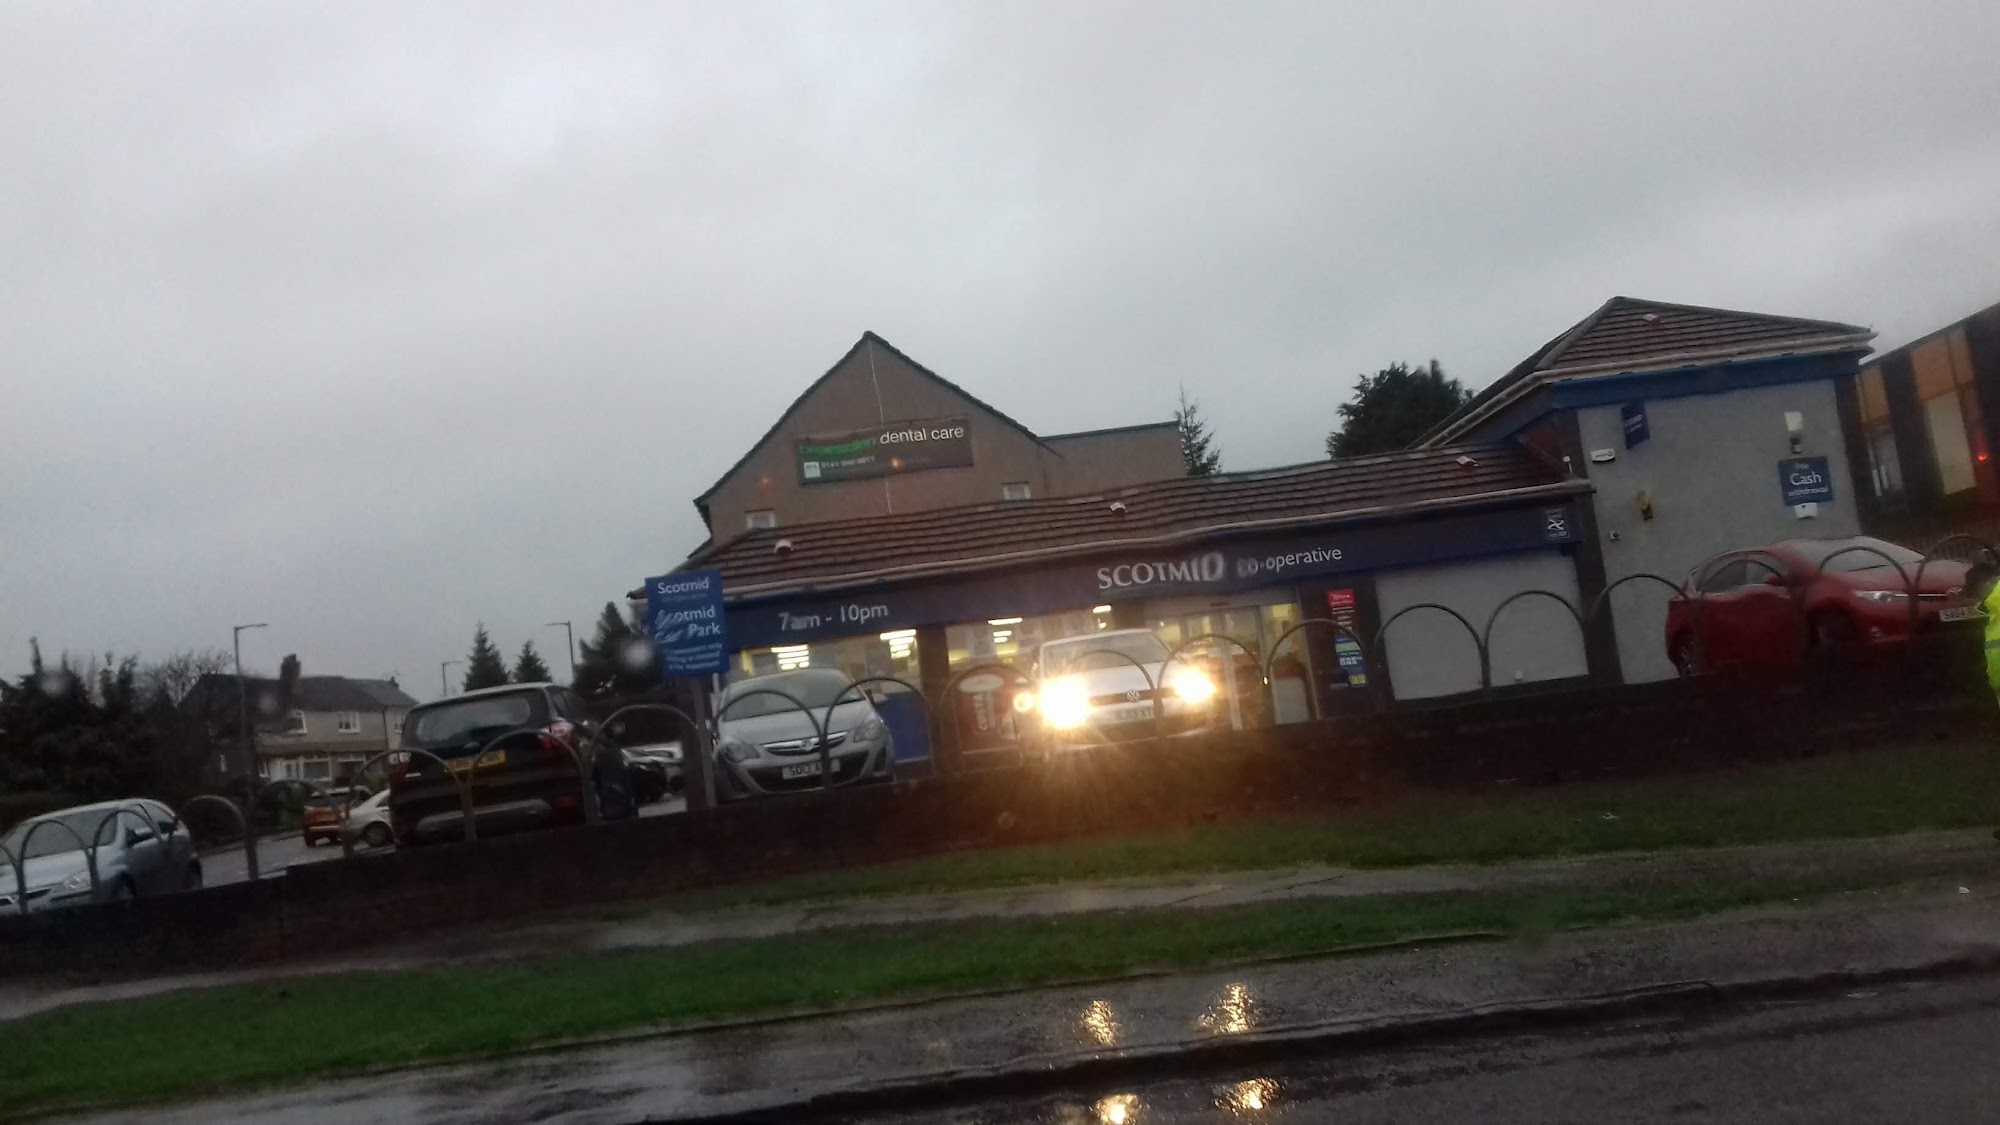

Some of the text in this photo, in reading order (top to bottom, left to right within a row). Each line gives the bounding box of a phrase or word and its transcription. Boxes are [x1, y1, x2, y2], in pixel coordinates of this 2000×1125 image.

[879, 426, 964, 445] dental care
[1790, 471, 1822, 485] Cash
[1096, 551, 1225, 590] SCOTMID
[657, 576, 710, 594] Scotmid
[778, 611, 821, 631] 7am
[840, 604, 889, 625] 10pm
[687, 622, 721, 639] Park
